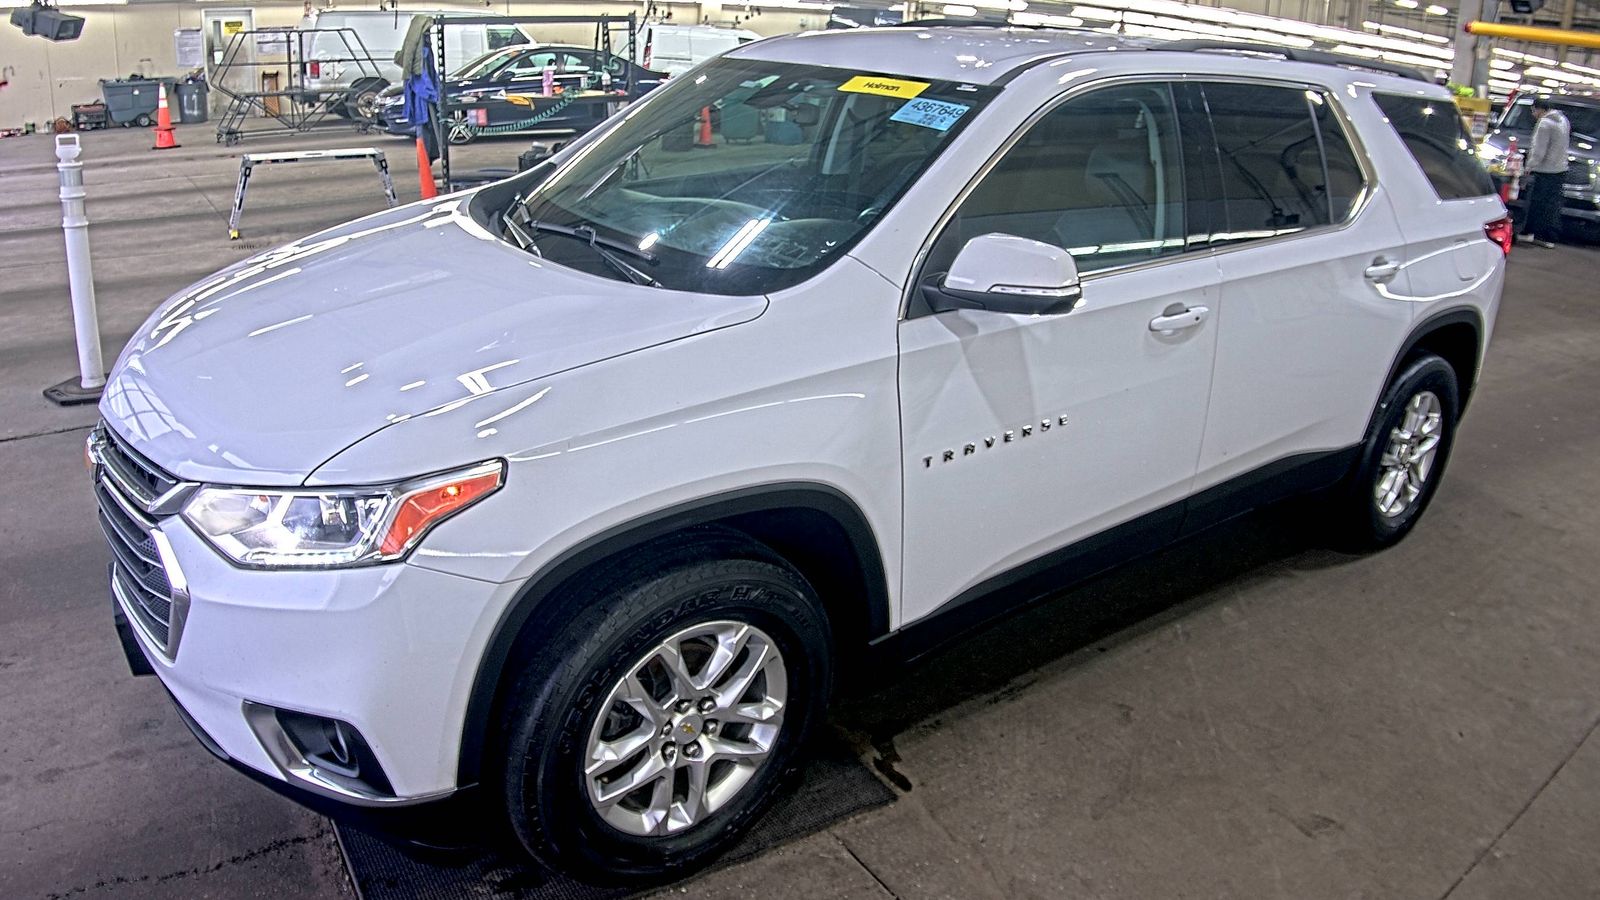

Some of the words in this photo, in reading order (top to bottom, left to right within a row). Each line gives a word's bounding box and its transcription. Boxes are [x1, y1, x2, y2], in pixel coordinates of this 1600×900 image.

[863, 81, 901, 92] Holman
[911, 101, 965, 118] 4367649
[923, 414, 1069, 468] TRAVERSE
